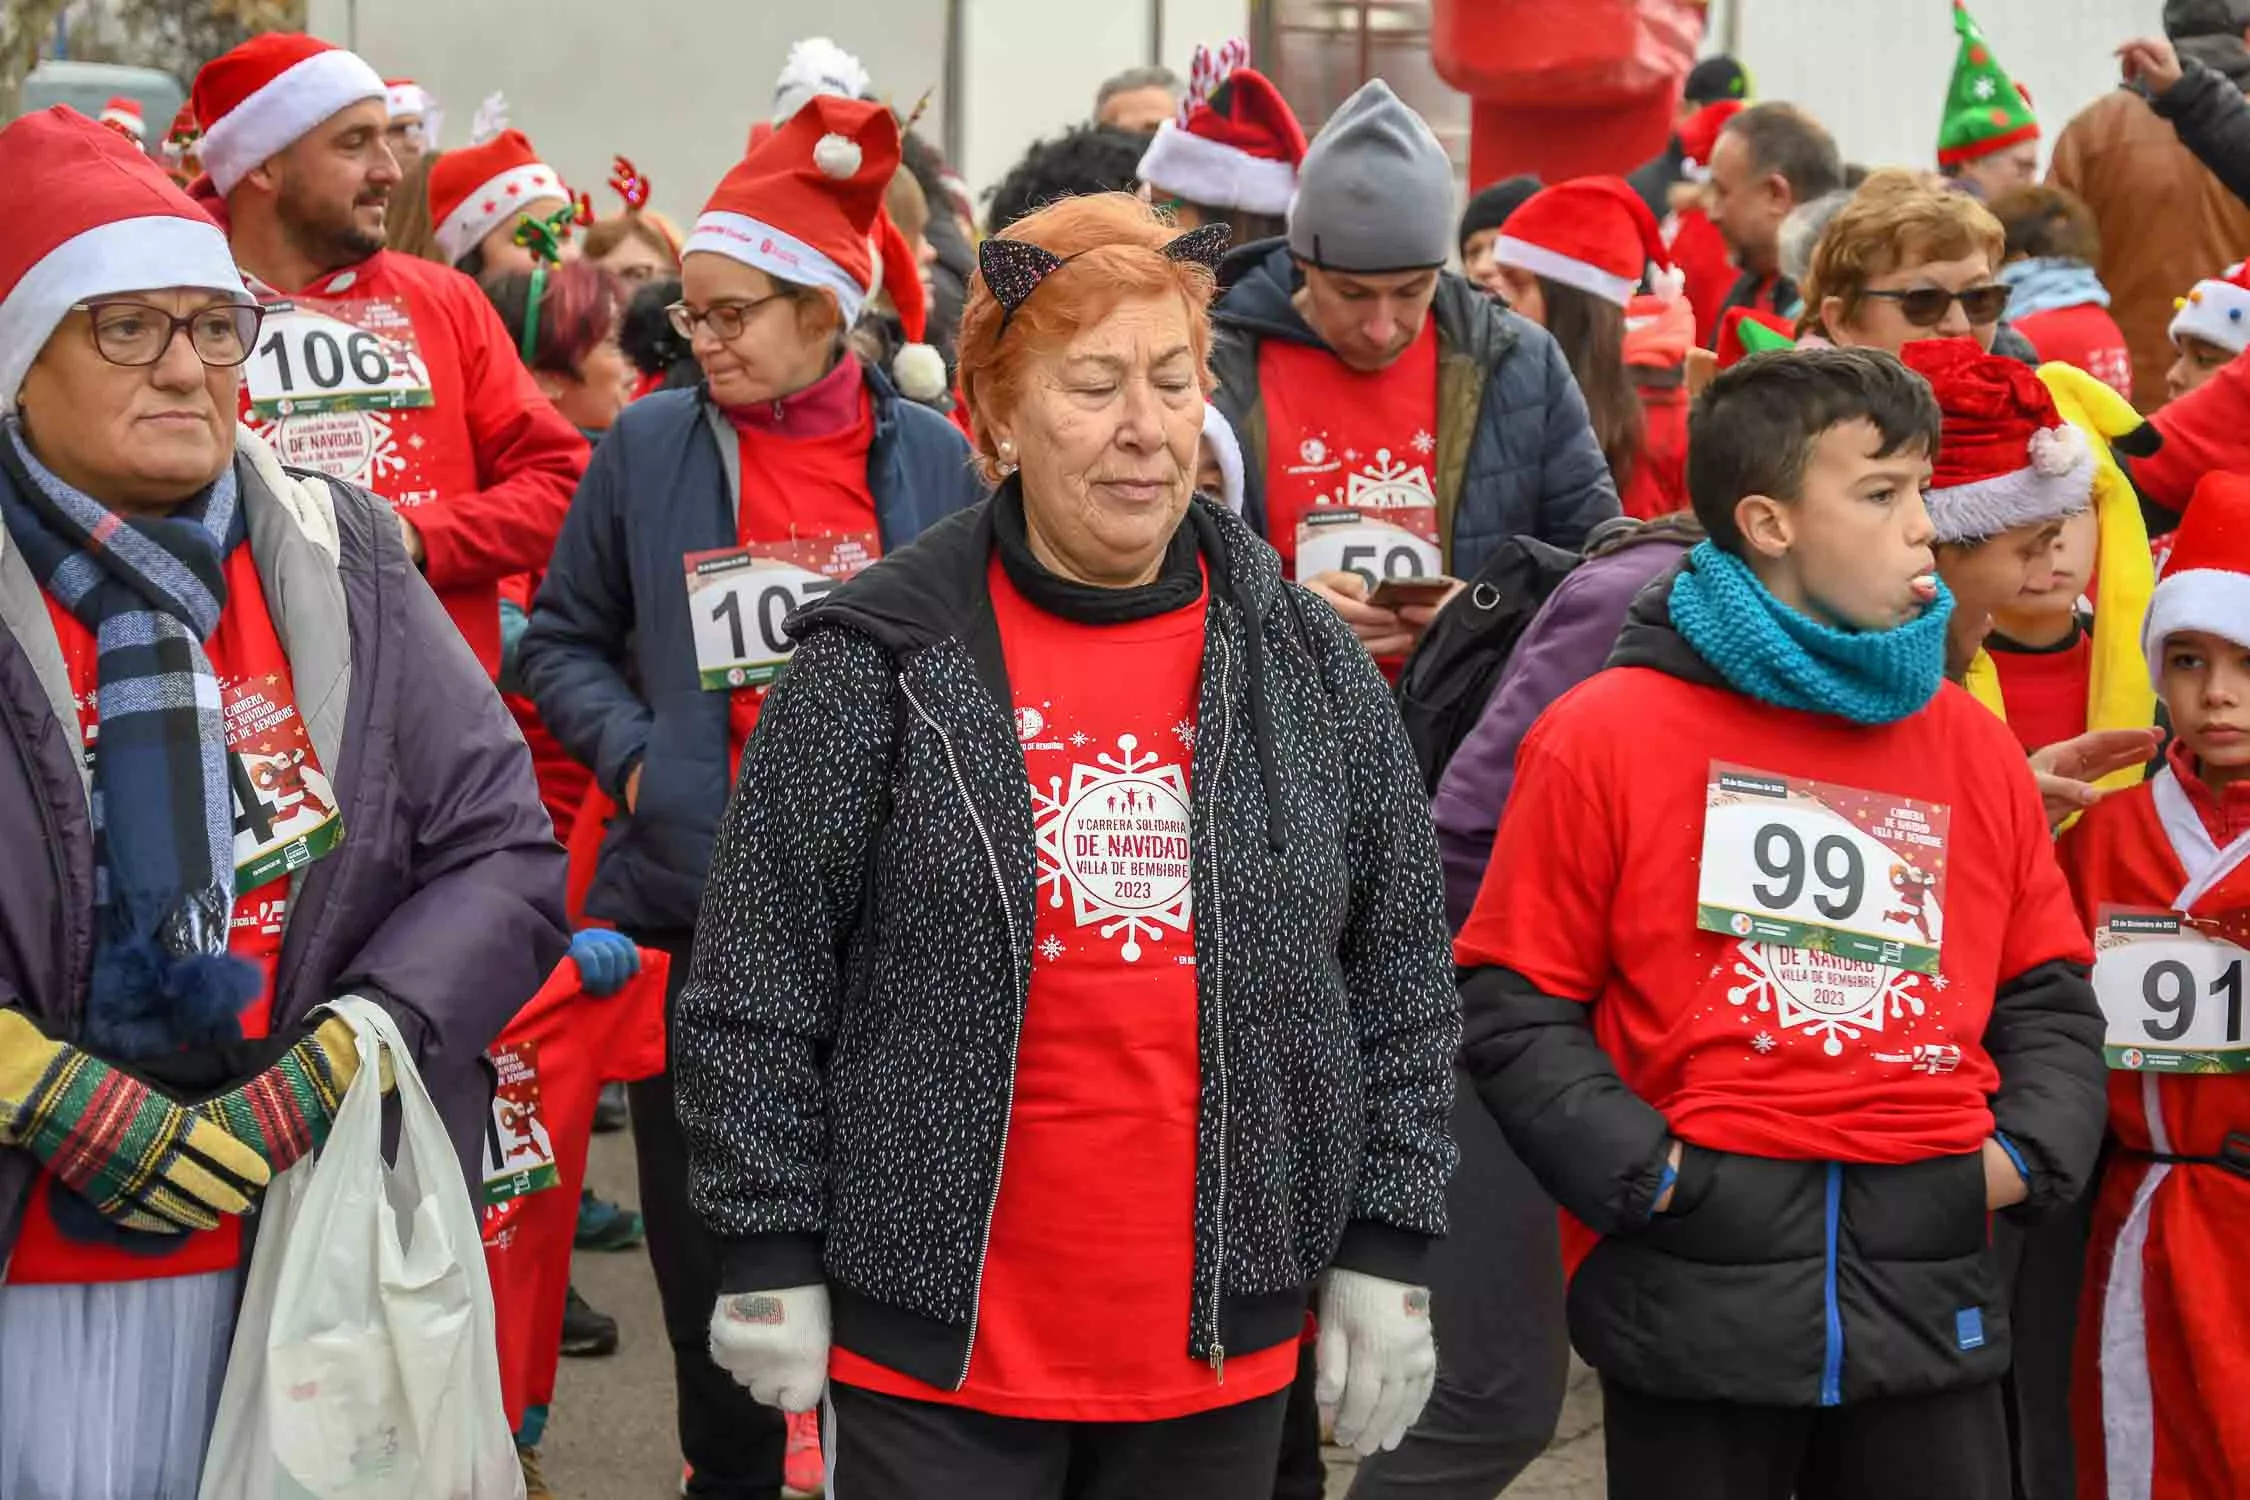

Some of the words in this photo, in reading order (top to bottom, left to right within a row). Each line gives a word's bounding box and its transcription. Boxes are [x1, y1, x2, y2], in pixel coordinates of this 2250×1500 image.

[260, 330, 390, 391] 106
[289, 436, 304, 453] DE
[310, 431, 363, 449] NAVIDAD
[234, 687, 242, 698] V
[224, 692, 265, 718] CARRERA
[223, 718, 236, 733] DE
[237, 701, 276, 726] NAVIDAD
[240, 727, 253, 738] DE
[253, 704, 296, 734] BEMBIBRE
[1077, 819, 1084, 831] V
[1086, 819, 1133, 831] CARRERA
[1136, 819, 1187, 834] SOLIDARIA
[1073, 834, 1100, 857] DE
[1108, 834, 1188, 860] NAVIDAD
[1076, 860, 1108, 875] VILLA
[1111, 861, 1126, 876] DE
[1131, 862, 1189, 878] BEMBIBRE
[1753, 823, 1865, 920] 99
[1114, 881, 1151, 899] 2023
[1780, 946, 1801, 966] DE
[1780, 967, 1808, 982] VILLA
[1811, 970, 1824, 984] DE
[1827, 972, 1877, 989] BEMBIBRE
[1814, 988, 1845, 1006] 2023
[2141, 959, 2242, 1042] 91
